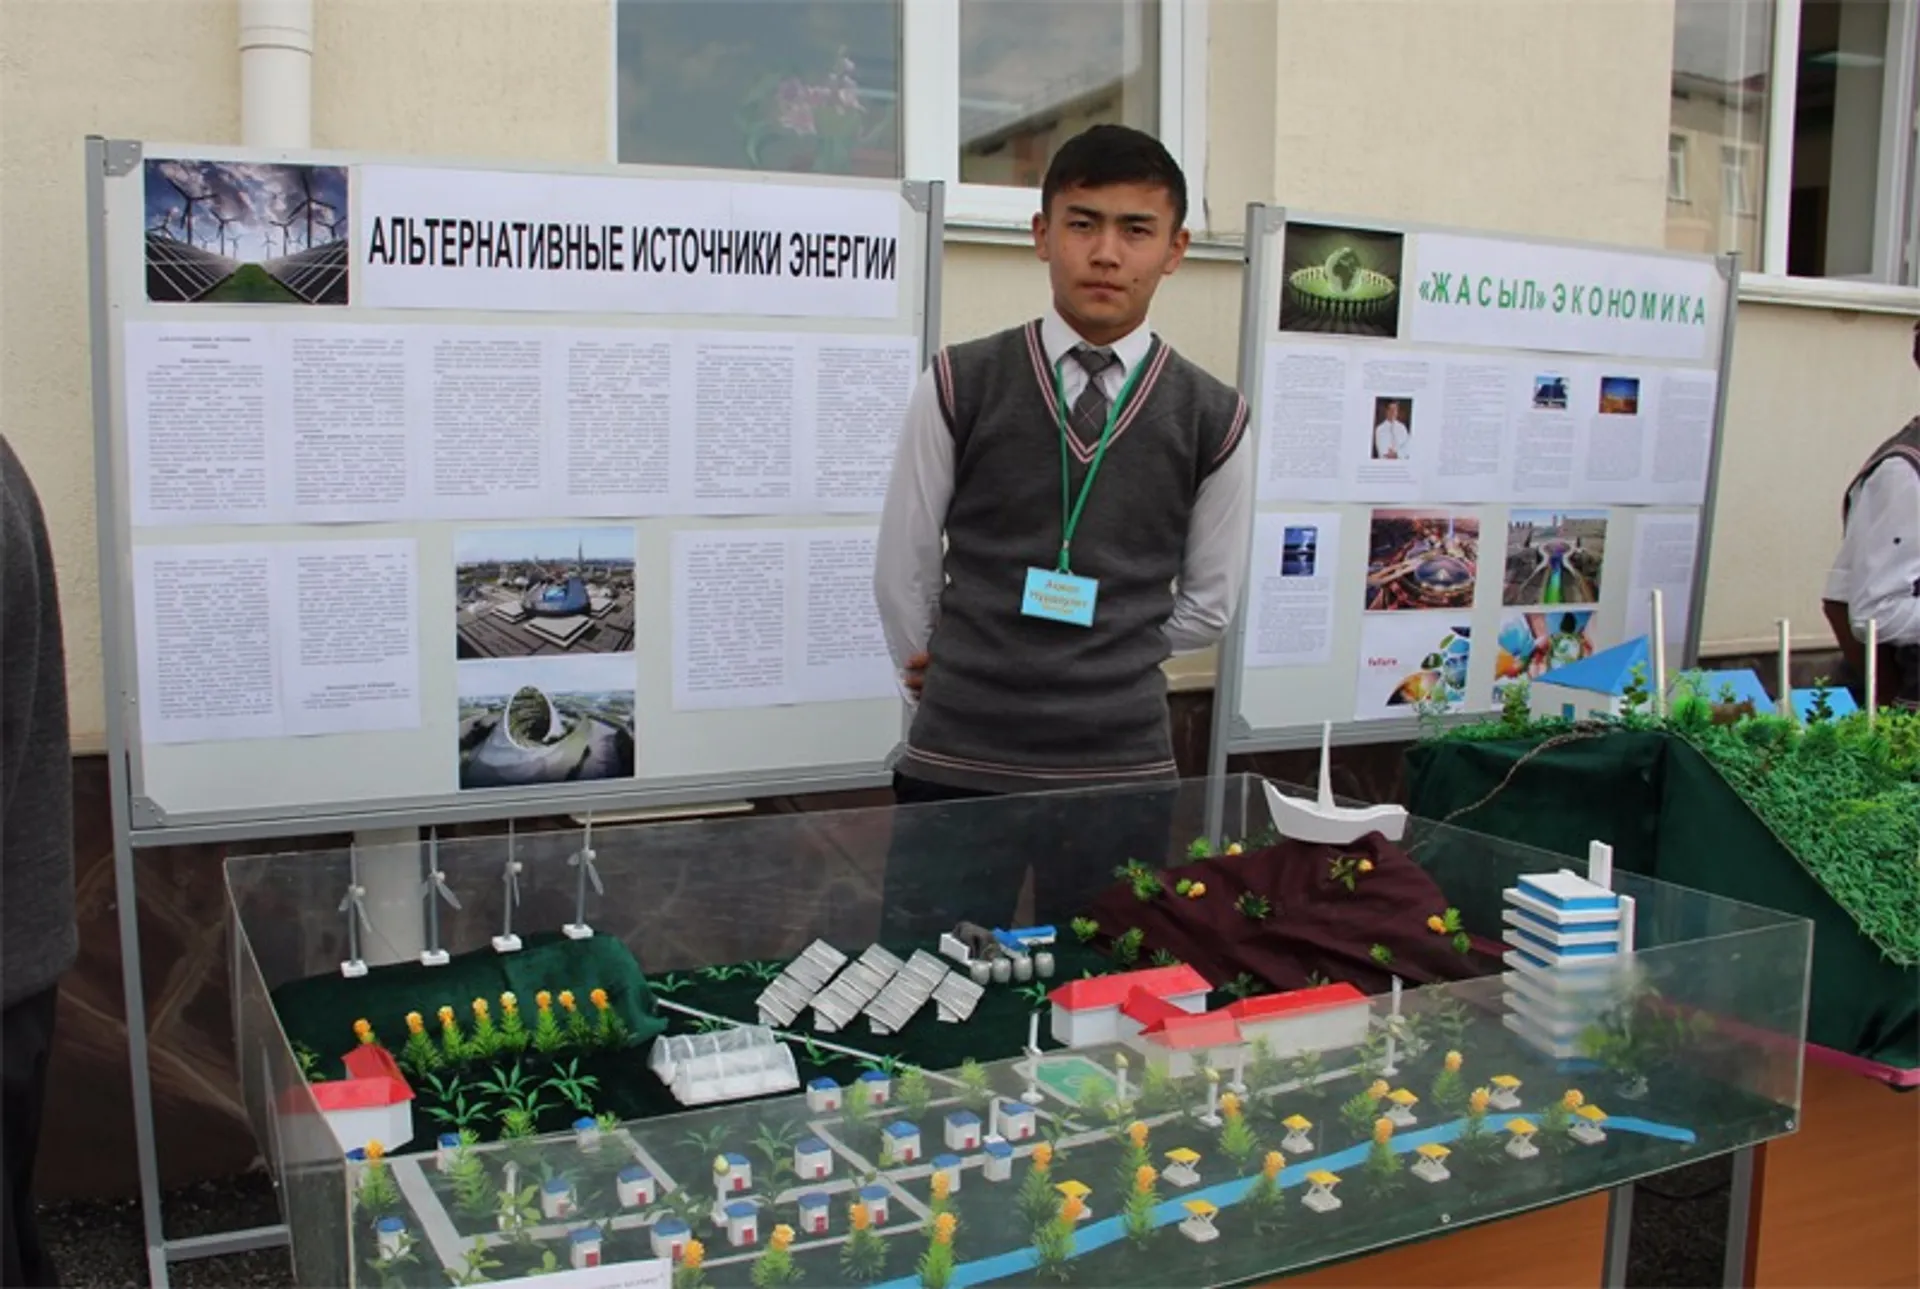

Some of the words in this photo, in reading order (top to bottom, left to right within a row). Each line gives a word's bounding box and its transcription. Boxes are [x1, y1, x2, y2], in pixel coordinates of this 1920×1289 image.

[368, 216, 624, 272] АЛЬТЕРНАТИВНЫЕ
[632, 226, 782, 275] ИСТОЧНИКИ
[788, 232, 897, 280] ЭНЕРГИИ
[1418, 271, 1547, 310] «ЖАСЫЛ»
[1552, 282, 1706, 325] ЭКОНОМИКА
